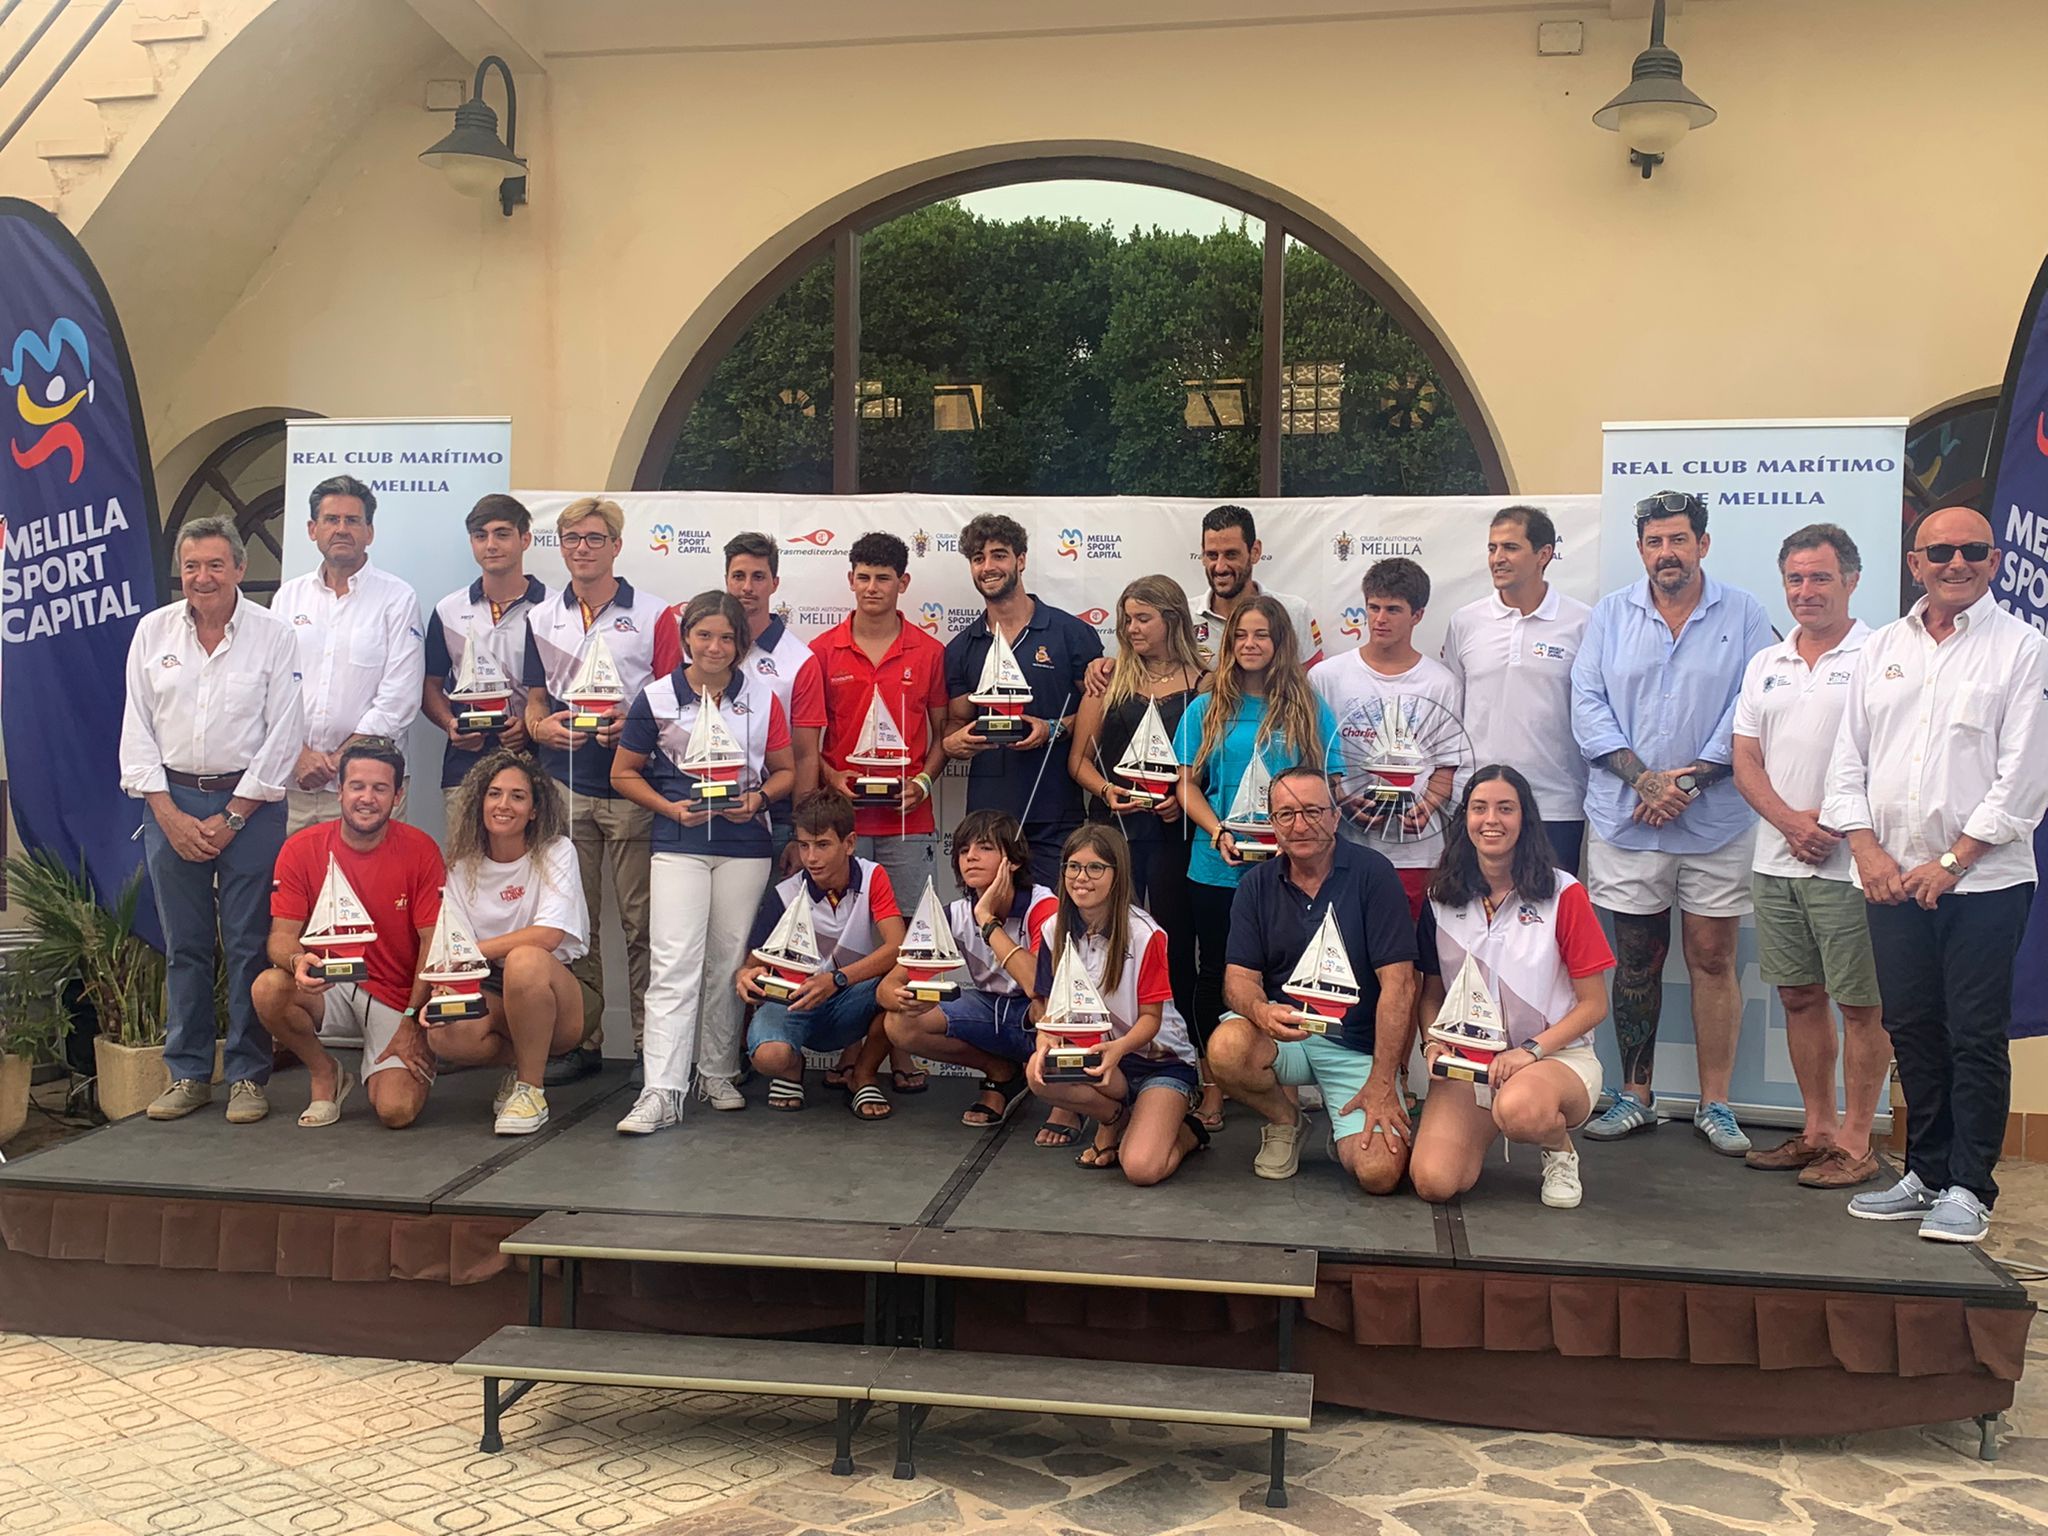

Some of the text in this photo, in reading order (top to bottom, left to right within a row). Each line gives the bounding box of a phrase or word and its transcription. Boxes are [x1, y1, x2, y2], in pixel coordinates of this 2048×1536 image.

[292, 449, 503, 465] REAL CLUB MARÍTIMO
[1611, 455, 1895, 475] REAL CLUB MARÍTIMO
[370, 480, 450, 492] MELILLA
[1718, 492, 1825, 505] MELILLA
[6, 497, 129, 562] MELILLA
[678, 530, 711, 538] MELILLA
[678, 538, 705, 546] SPORT
[1087, 535, 1122, 543] MELILLA
[677, 546, 711, 554] CAPITAL
[1087, 543, 1115, 551] SPORT
[1361, 543, 1422, 555] MELILLA
[1087, 551, 1122, 559] CAPITAL
[2, 543, 107, 603] SPORT
[2, 580, 141, 643] CAPITAL
[799, 613, 842, 625] MELILL
